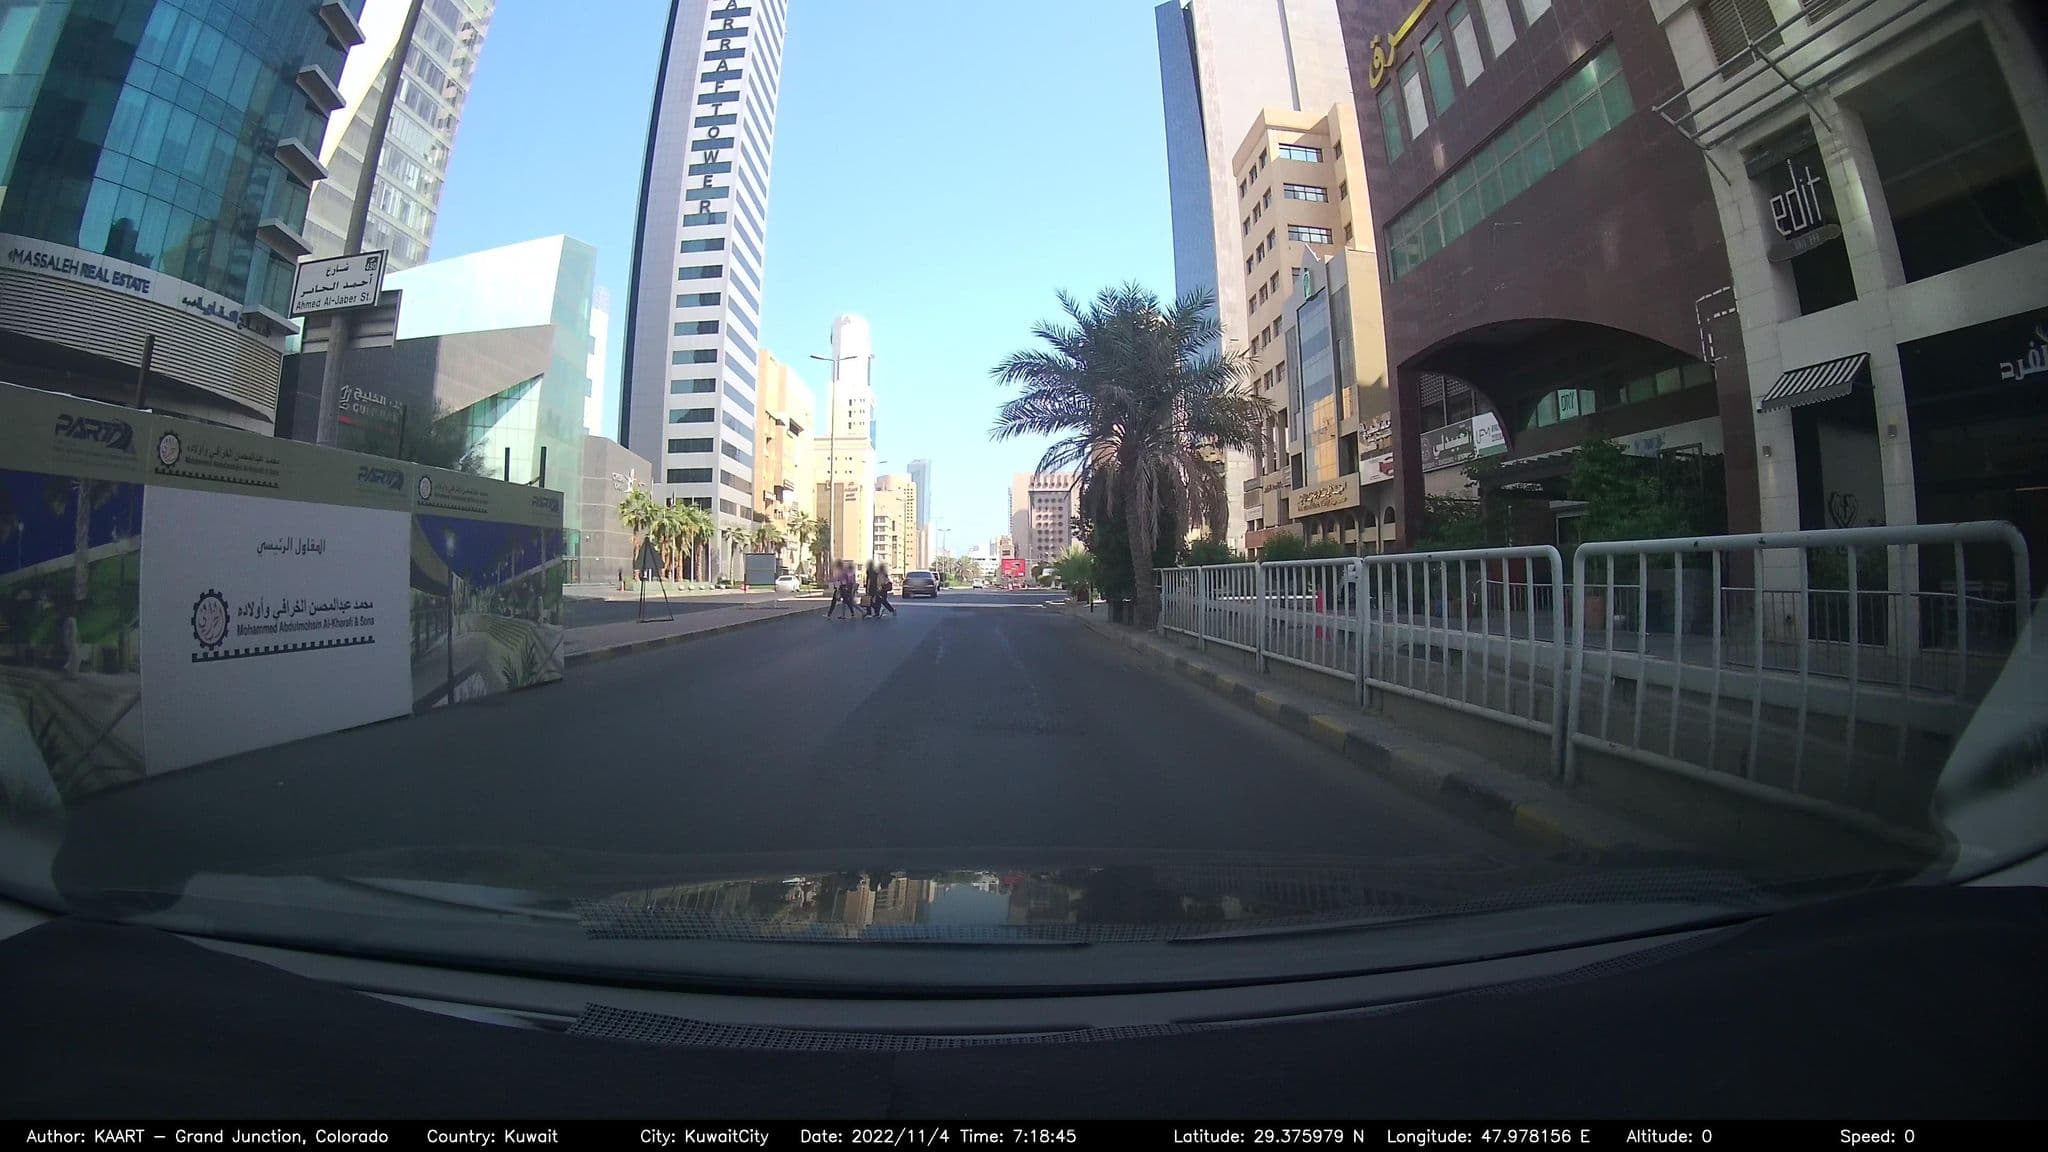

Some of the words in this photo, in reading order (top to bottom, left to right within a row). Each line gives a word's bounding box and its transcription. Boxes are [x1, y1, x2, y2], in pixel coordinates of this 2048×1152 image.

[1770, 158, 1822, 236] edit
[12, 247, 80, 276] MASSALEH
[80, 262, 110, 283] REAL
[111, 270, 151, 294] ESTATE
[343, 273, 373, 289] أحمد
[295, 299, 321, 311] Ahmed
[323, 294, 357, 306] Al-Jaber
[359, 291, 372, 302] St.
[295, 538, 326, 555] المقاول
[353, 600, 373, 610] محمد
[236, 622, 278, 637] Mohammed
